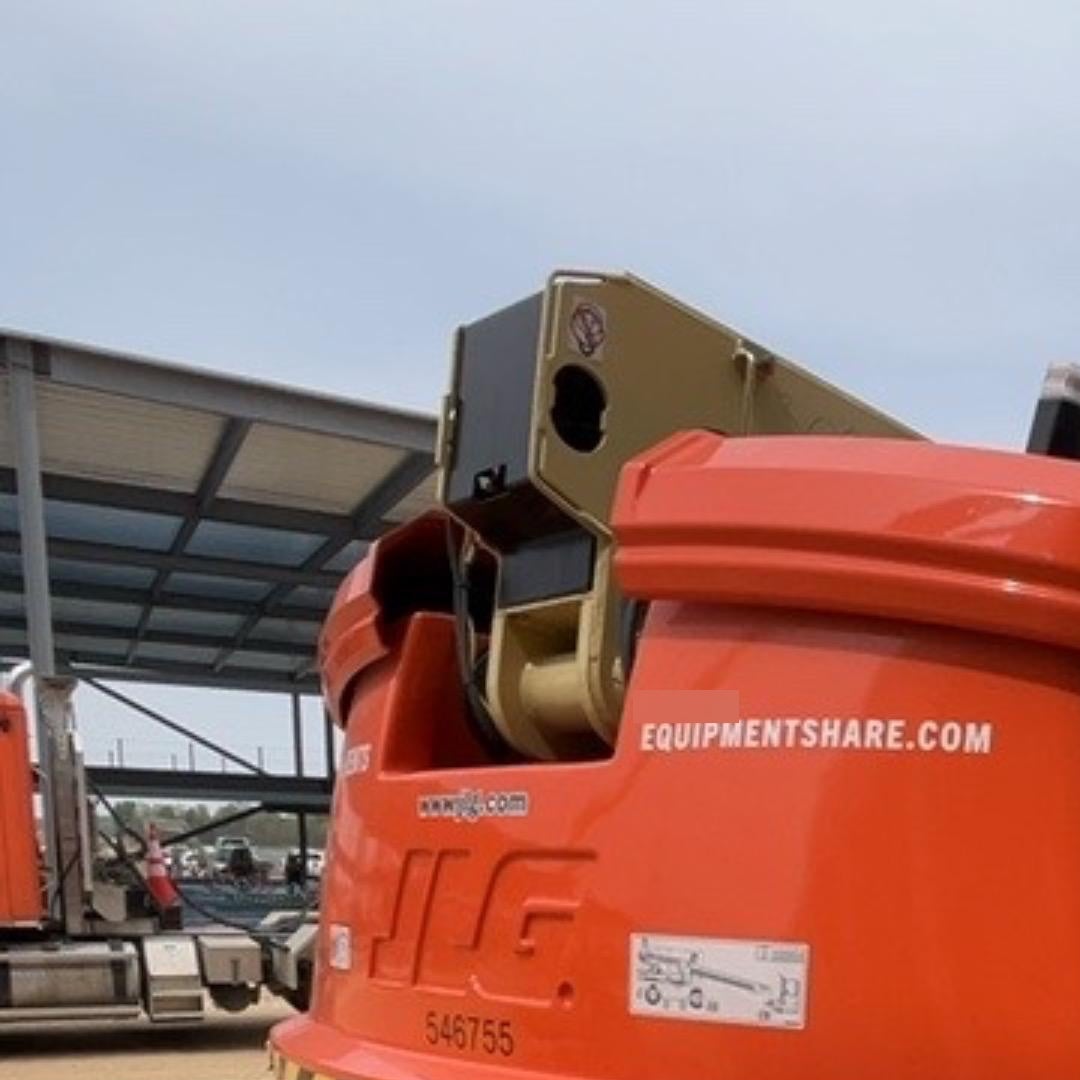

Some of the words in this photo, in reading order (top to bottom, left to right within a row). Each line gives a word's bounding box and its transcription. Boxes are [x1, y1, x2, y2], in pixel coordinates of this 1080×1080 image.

[640, 718, 993, 754] EQUIPMENTSHARE.COM
[368, 848, 598, 1008] JLG
[424, 1010, 515, 1058] 546755
